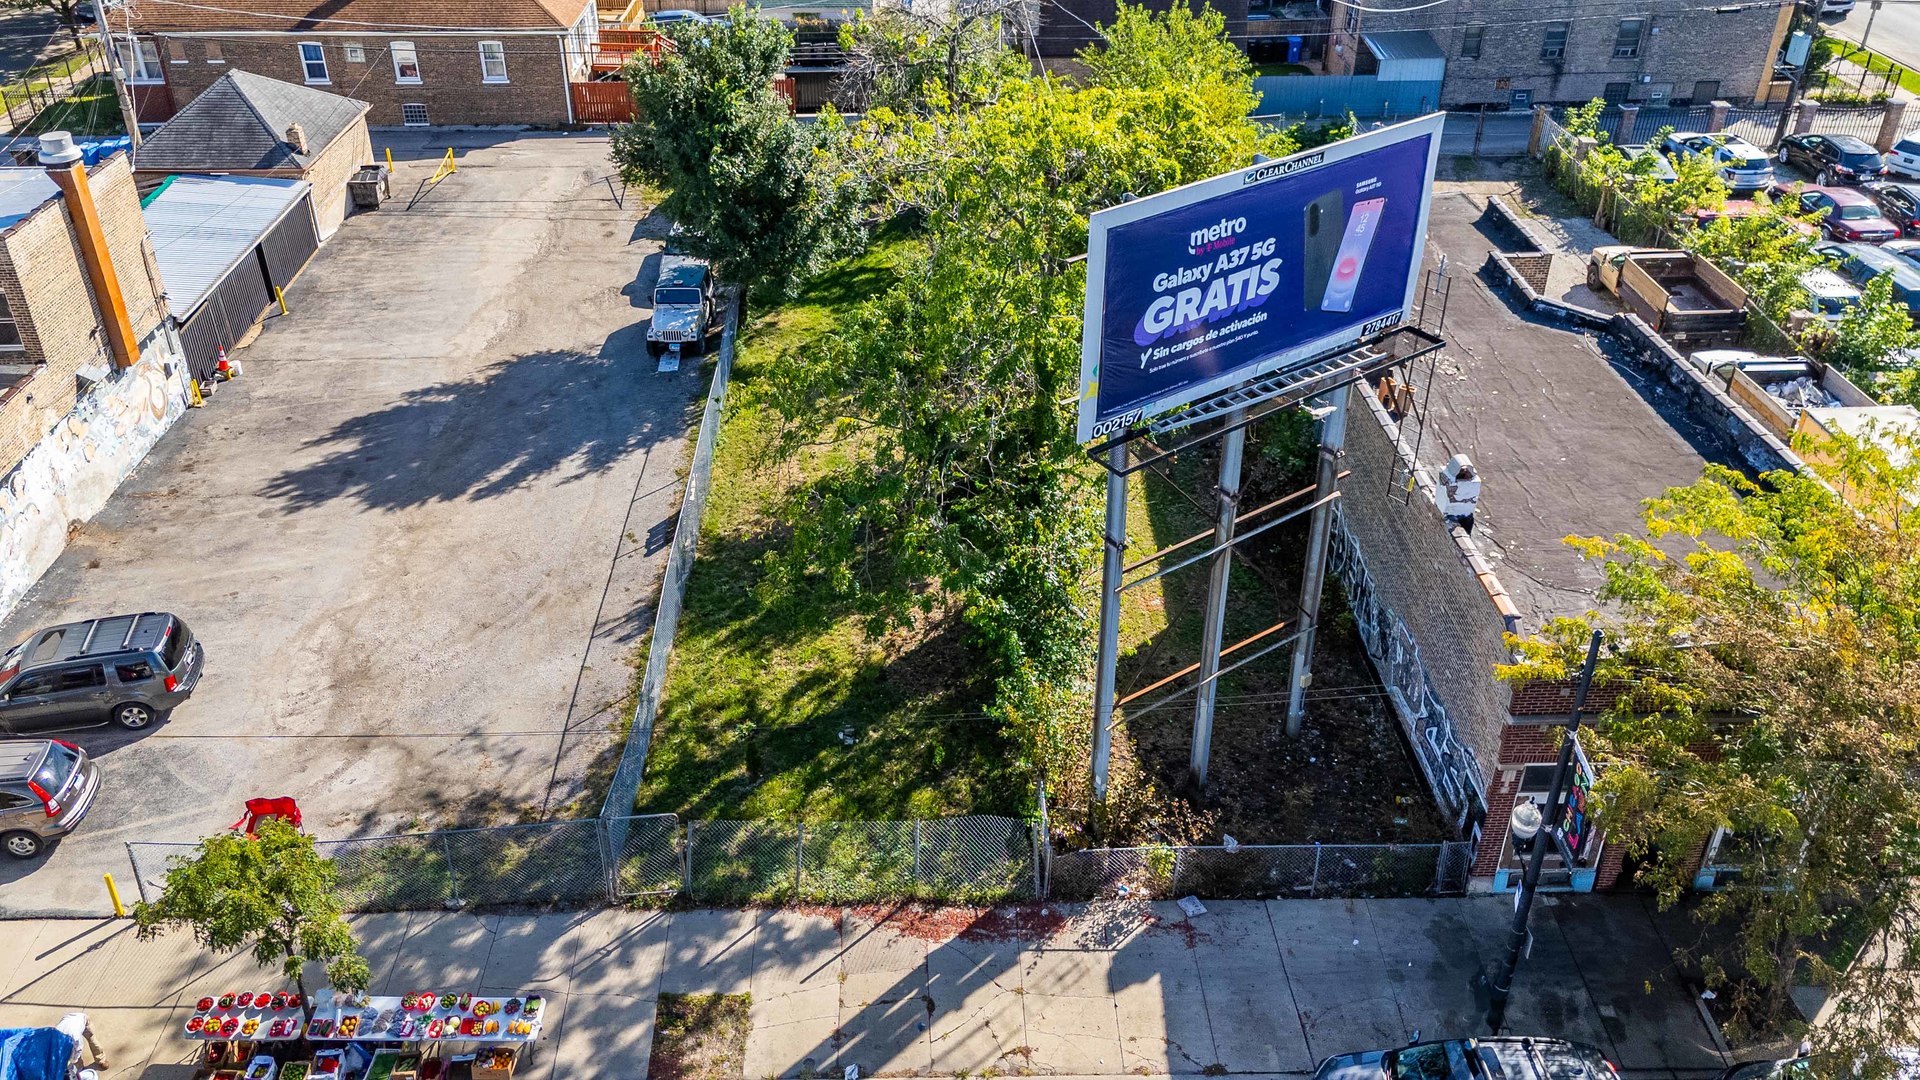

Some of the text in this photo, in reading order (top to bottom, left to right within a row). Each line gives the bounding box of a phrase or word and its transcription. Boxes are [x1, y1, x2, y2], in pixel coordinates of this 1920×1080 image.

[1188, 216, 1247, 255] metro
[1196, 246, 1204, 256] by
[1153, 237, 1276, 292] Galaxy A37 5G
[1143, 258, 1283, 334] GRATIS
[1140, 311, 1268, 369] Y Sin cargos de activación
[1364, 312, 1401, 336] 2784417
[1093, 409, 1142, 438] 002157
